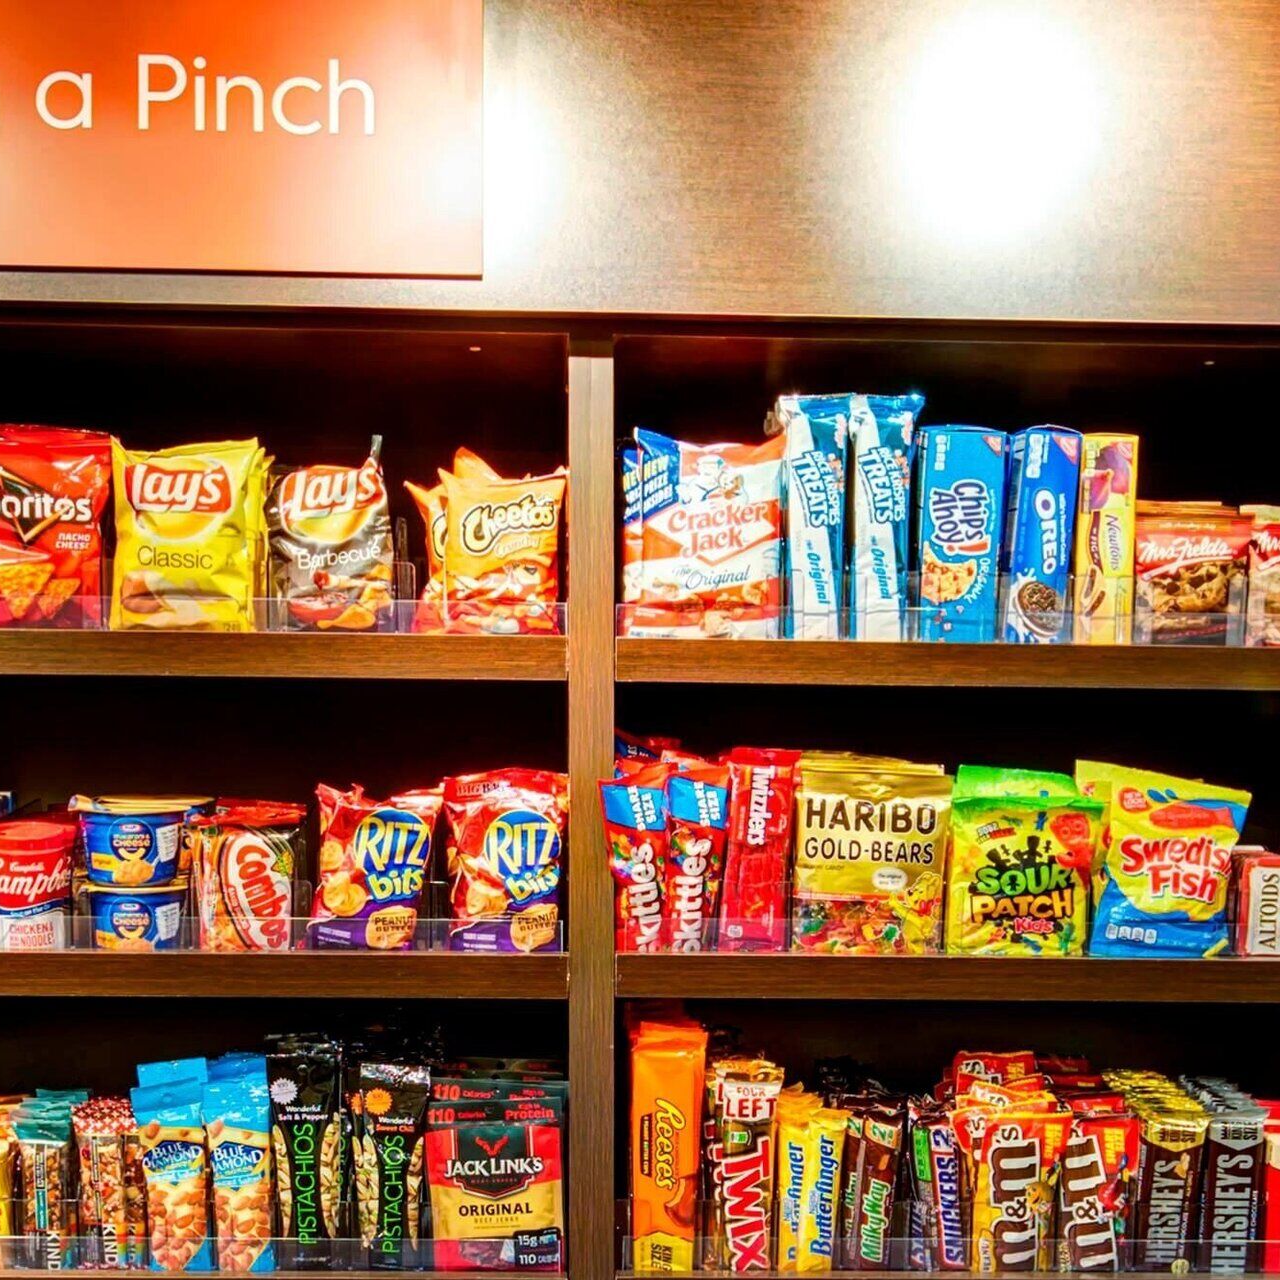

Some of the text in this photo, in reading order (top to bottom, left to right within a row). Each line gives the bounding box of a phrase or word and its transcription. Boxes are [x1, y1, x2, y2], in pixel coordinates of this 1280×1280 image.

[35, 71, 93, 129] a
[138, 54, 375, 135] Pinch
[131, 464, 225, 512] Lay's
[289, 467, 377, 518] Lay's
[792, 451, 828, 528] TREATS
[858, 447, 893, 524] TREATS
[461, 494, 555, 553] Cheetos
[668, 502, 769, 533] Cracker
[953, 481, 988, 542] Chips
[57, 532, 91, 542] NACHO
[682, 527, 744, 558] Jack
[1035, 489, 1058, 575] OREO
[1105, 514, 1121, 571] Newtons
[137, 545, 214, 571] Classic
[298, 543, 381, 570] Barbecue
[685, 565, 751, 591] Original
[807, 552, 831, 605] Original
[871, 547, 893, 600] Original
[747, 765, 776, 847] Twizzlers
[806, 799, 937, 835] HARIBO
[357, 817, 428, 870] RITZ
[488, 822, 559, 874] RITZ
[805, 836, 935, 866] GOLD-BEARS
[236, 843, 287, 949] Combos
[369, 868, 424, 900] bits
[506, 865, 559, 897] bits
[976, 864, 1071, 896] SOUR
[1148, 864, 1219, 903] Fish
[375, 915, 414, 926] PEANUT
[517, 913, 557, 925] PEANUT
[971, 889, 1074, 924] PATCH
[1258, 873, 1280, 950] ALTOIDS
[10, 921, 48, 934] CHICKEN
[1013, 916, 1055, 934] Kids
[435, 1084, 460, 1101] 110
[737, 1087, 766, 1097] FOUR
[278, 1113, 329, 1122] Salt & Pepper
[286, 1104, 321, 1114] Wonderful
[379, 1116, 414, 1126] Wonderful
[428, 1108, 455, 1125] 110
[505, 1109, 556, 1121] Protein
[725, 1098, 777, 1119] LEFT
[376, 1124, 396, 1132] Sweet
[655, 1097, 687, 1191] Reese's
[931, 1129, 951, 1151] 2
[141, 1147, 203, 1171] DIAMOND
[212, 1144, 245, 1161] BLUE
[445, 1157, 544, 1178] JACK LINK'S
[294, 1124, 318, 1245] PISTACHIOS
[382, 1135, 405, 1255] PISTACHIOS
[809, 1134, 839, 1257] Butterfinger
[459, 1203, 533, 1217] ORIGINAL
[723, 1136, 770, 1271] TWIX
[935, 1156, 964, 1265] SNICKERS
[1144, 1159, 1186, 1264] HERSHEY'S
[1210, 1154, 1254, 1273] HERSHEY'S
[46, 1231, 61, 1270] KIND
[102, 1223, 119, 1265] KIND
[518, 1234, 538, 1247] 15g
[519, 1253, 536, 1264] 110
[651, 1243, 673, 1271] KING SIZE
